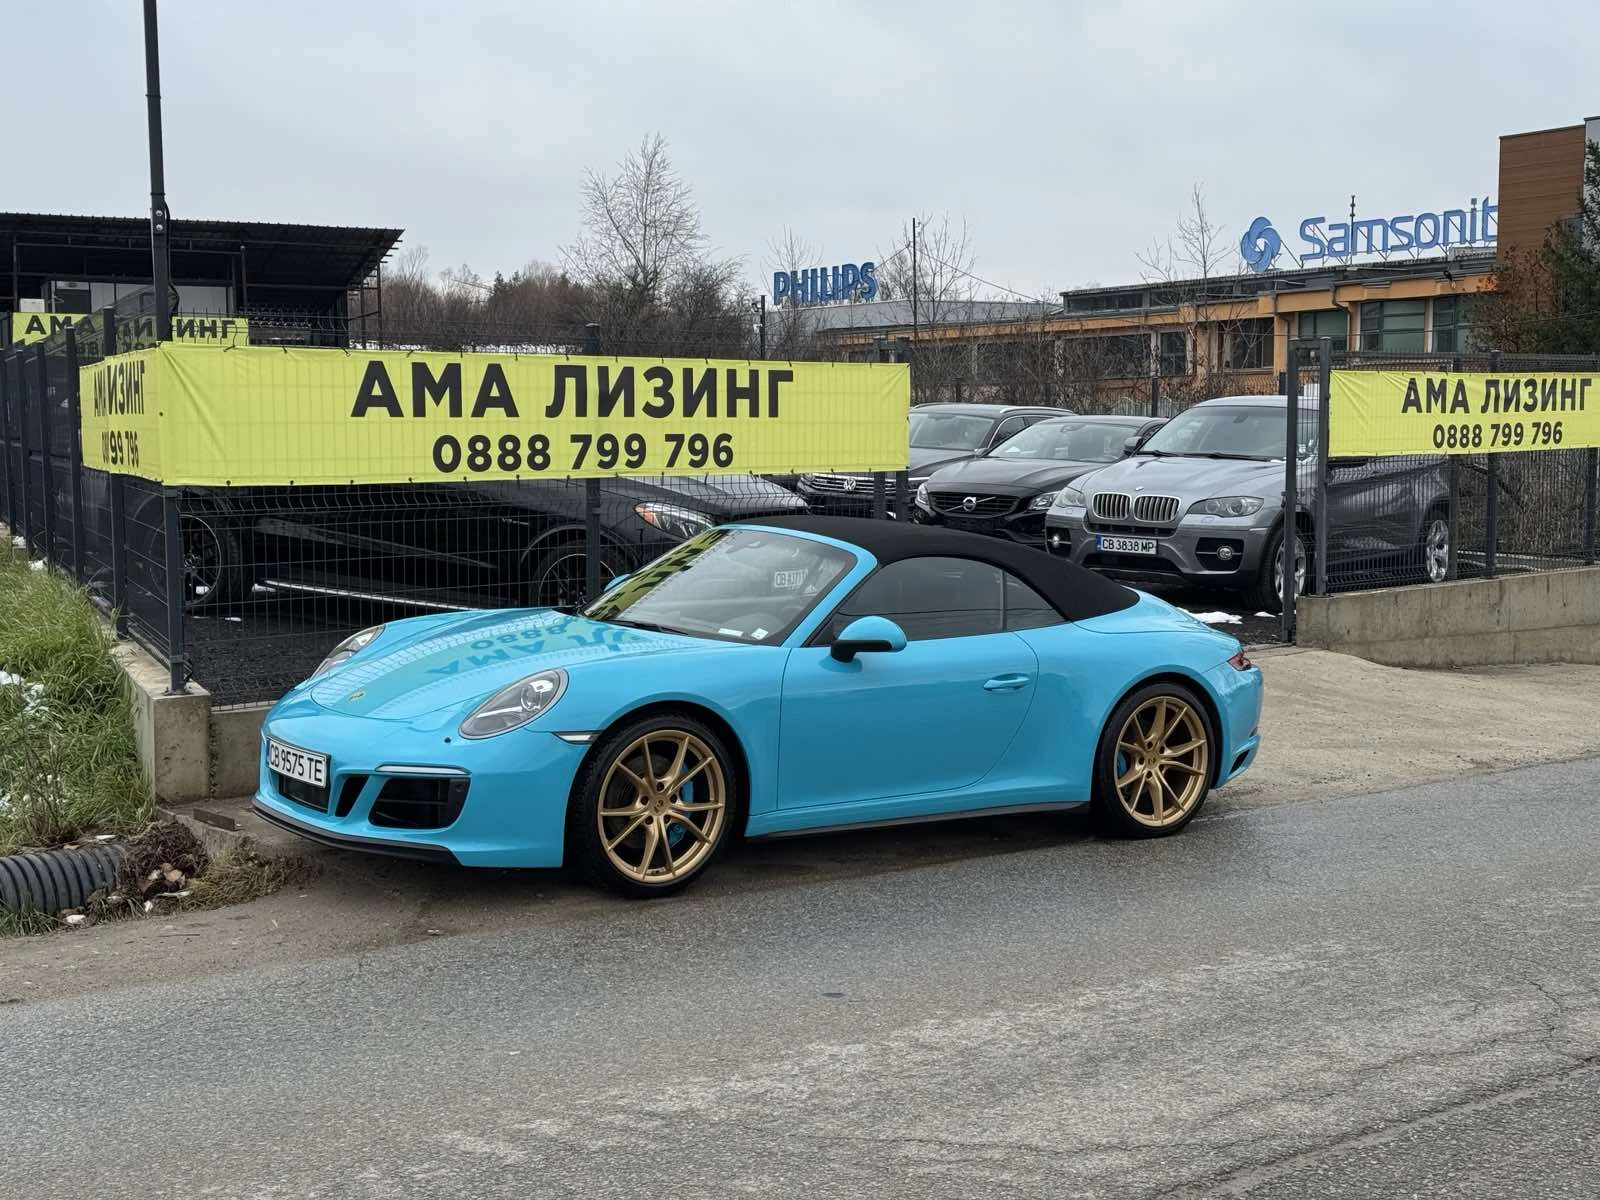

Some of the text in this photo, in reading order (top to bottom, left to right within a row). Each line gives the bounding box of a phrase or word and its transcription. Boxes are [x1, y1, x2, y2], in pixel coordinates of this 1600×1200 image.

[1299, 196, 1498, 261] Samsonit
[773, 262, 877, 305] PHILIPS
[350, 360, 794, 419] АМА ЛИЗИНГ
[1401, 377, 1592, 414] АМА ЛИЗИНГ
[432, 432, 734, 474] 0888 799 796
[1433, 420, 1564, 448] 0888 799 796
[1116, 540, 1139, 551] 3838
[1141, 541, 1154, 552] MP
[270, 744, 323, 782] CB 9575 TE
